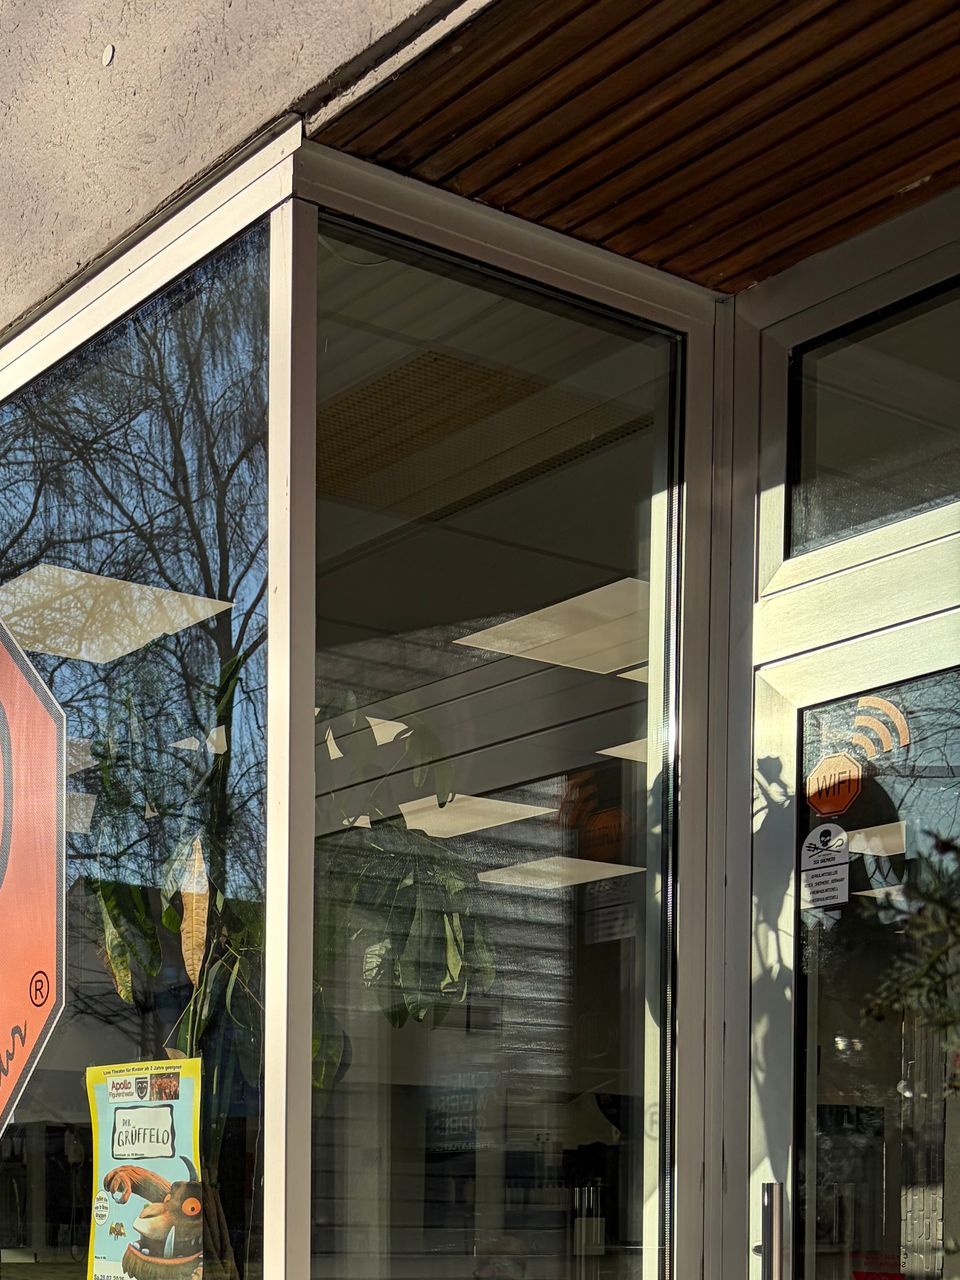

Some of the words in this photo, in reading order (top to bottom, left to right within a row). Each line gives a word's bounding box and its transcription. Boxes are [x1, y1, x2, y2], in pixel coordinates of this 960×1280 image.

[816, 769, 852, 800] WIFI
[111, 1080, 132, 1090] Apollo
[117, 1126, 170, 1147] GRÜFFELO
